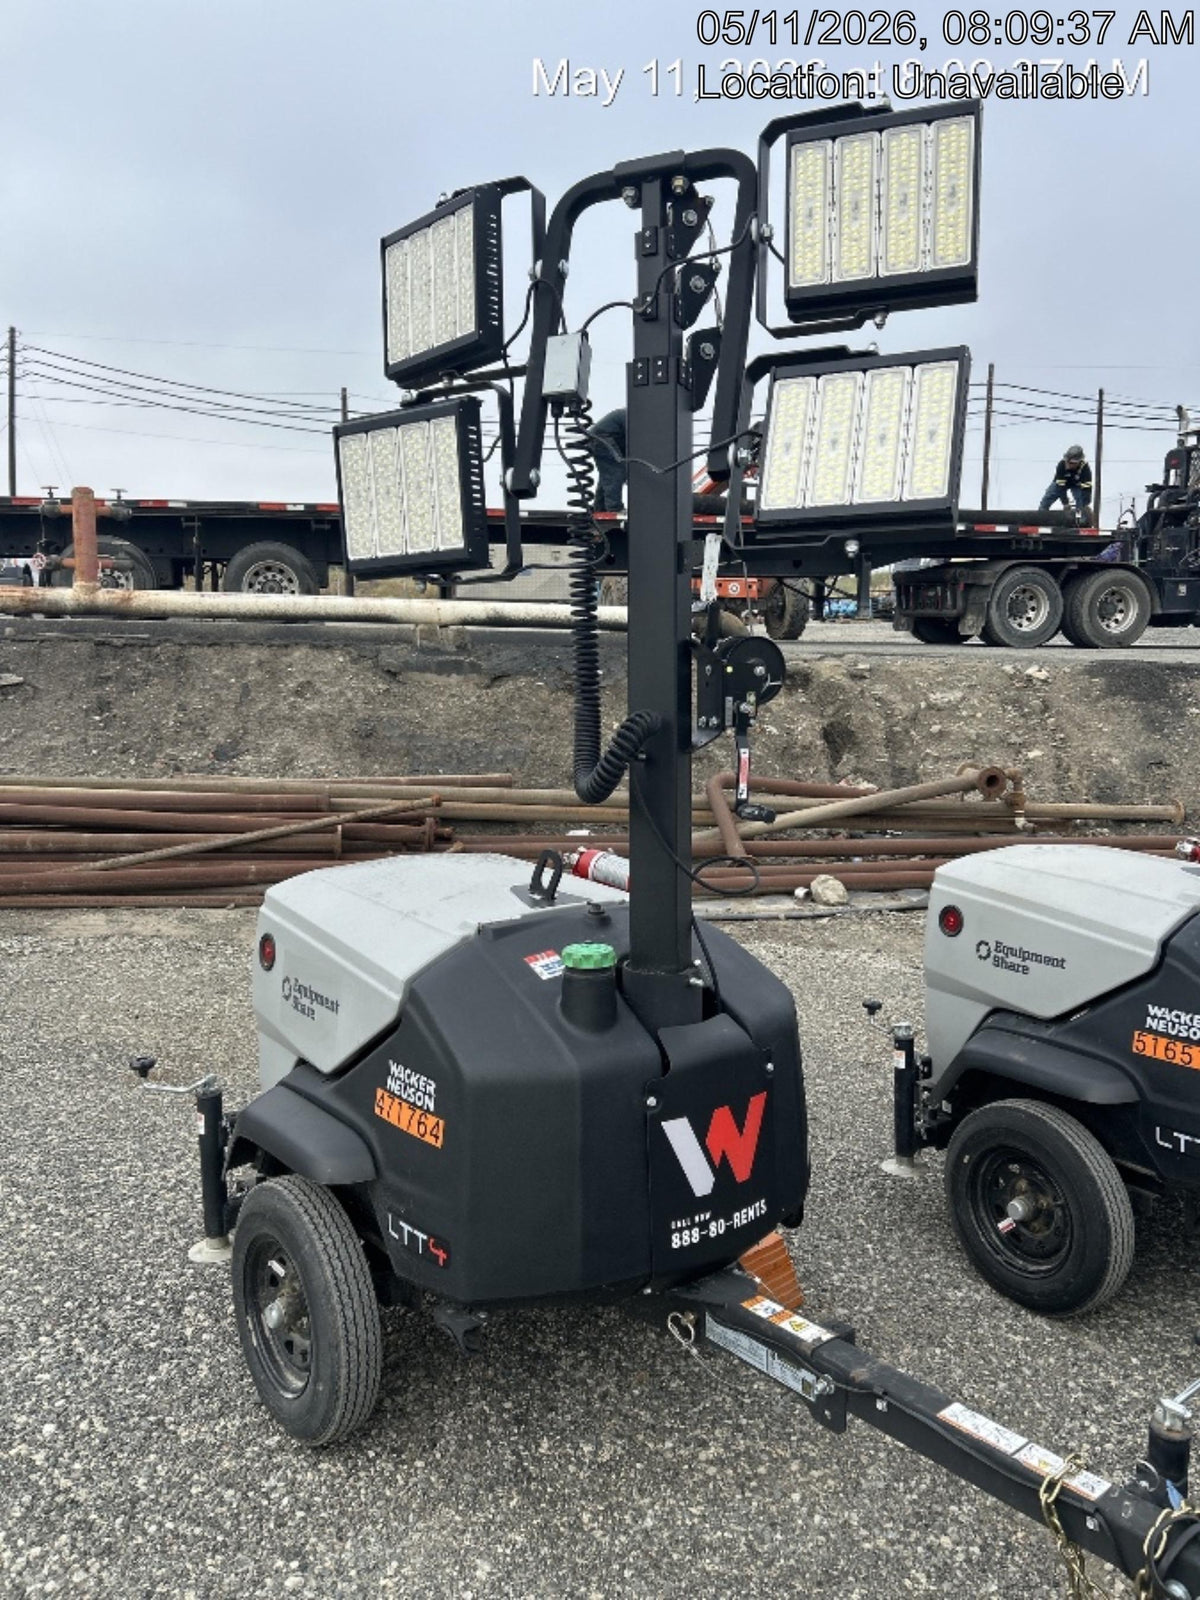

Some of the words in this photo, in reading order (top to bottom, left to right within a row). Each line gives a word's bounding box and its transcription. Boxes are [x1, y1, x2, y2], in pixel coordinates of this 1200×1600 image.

[992, 954, 1030, 975] Share
[993, 940, 1066, 970] Equipment
[1135, 1032, 1200, 1066] 5165
[386, 1076, 435, 1112] NEUSON
[388, 1059, 436, 1097] WACKER
[375, 1092, 441, 1144] 471764
[1155, 1126, 1200, 1153] LT
[671, 1198, 767, 1249] 888-80-RENTS
